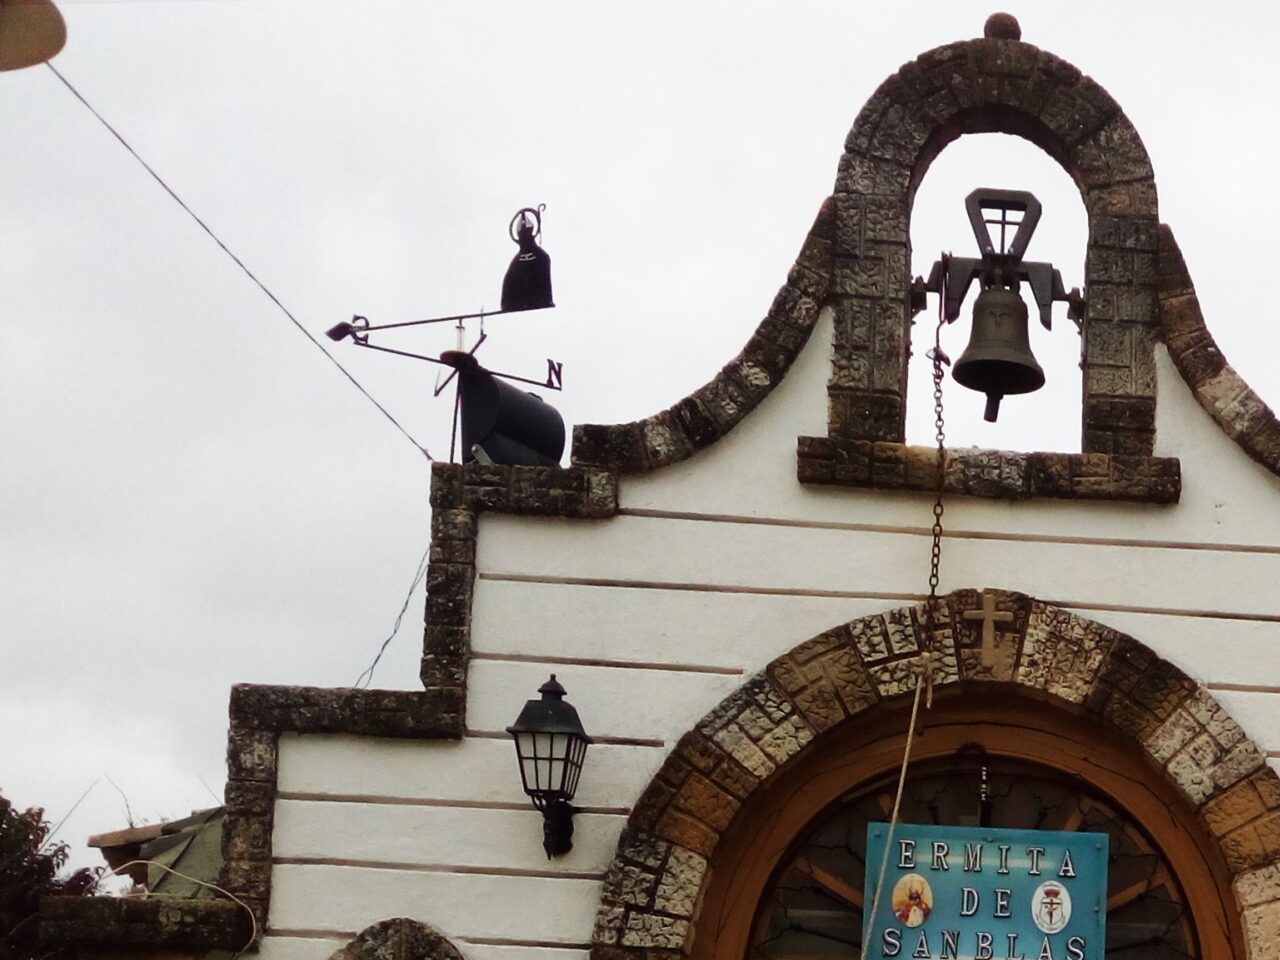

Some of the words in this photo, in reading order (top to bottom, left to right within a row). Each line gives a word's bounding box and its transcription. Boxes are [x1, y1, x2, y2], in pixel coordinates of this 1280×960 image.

[546, 358, 563, 391] N
[897, 839, 1077, 878] ERMITA
[959, 887, 1012, 918] DE
